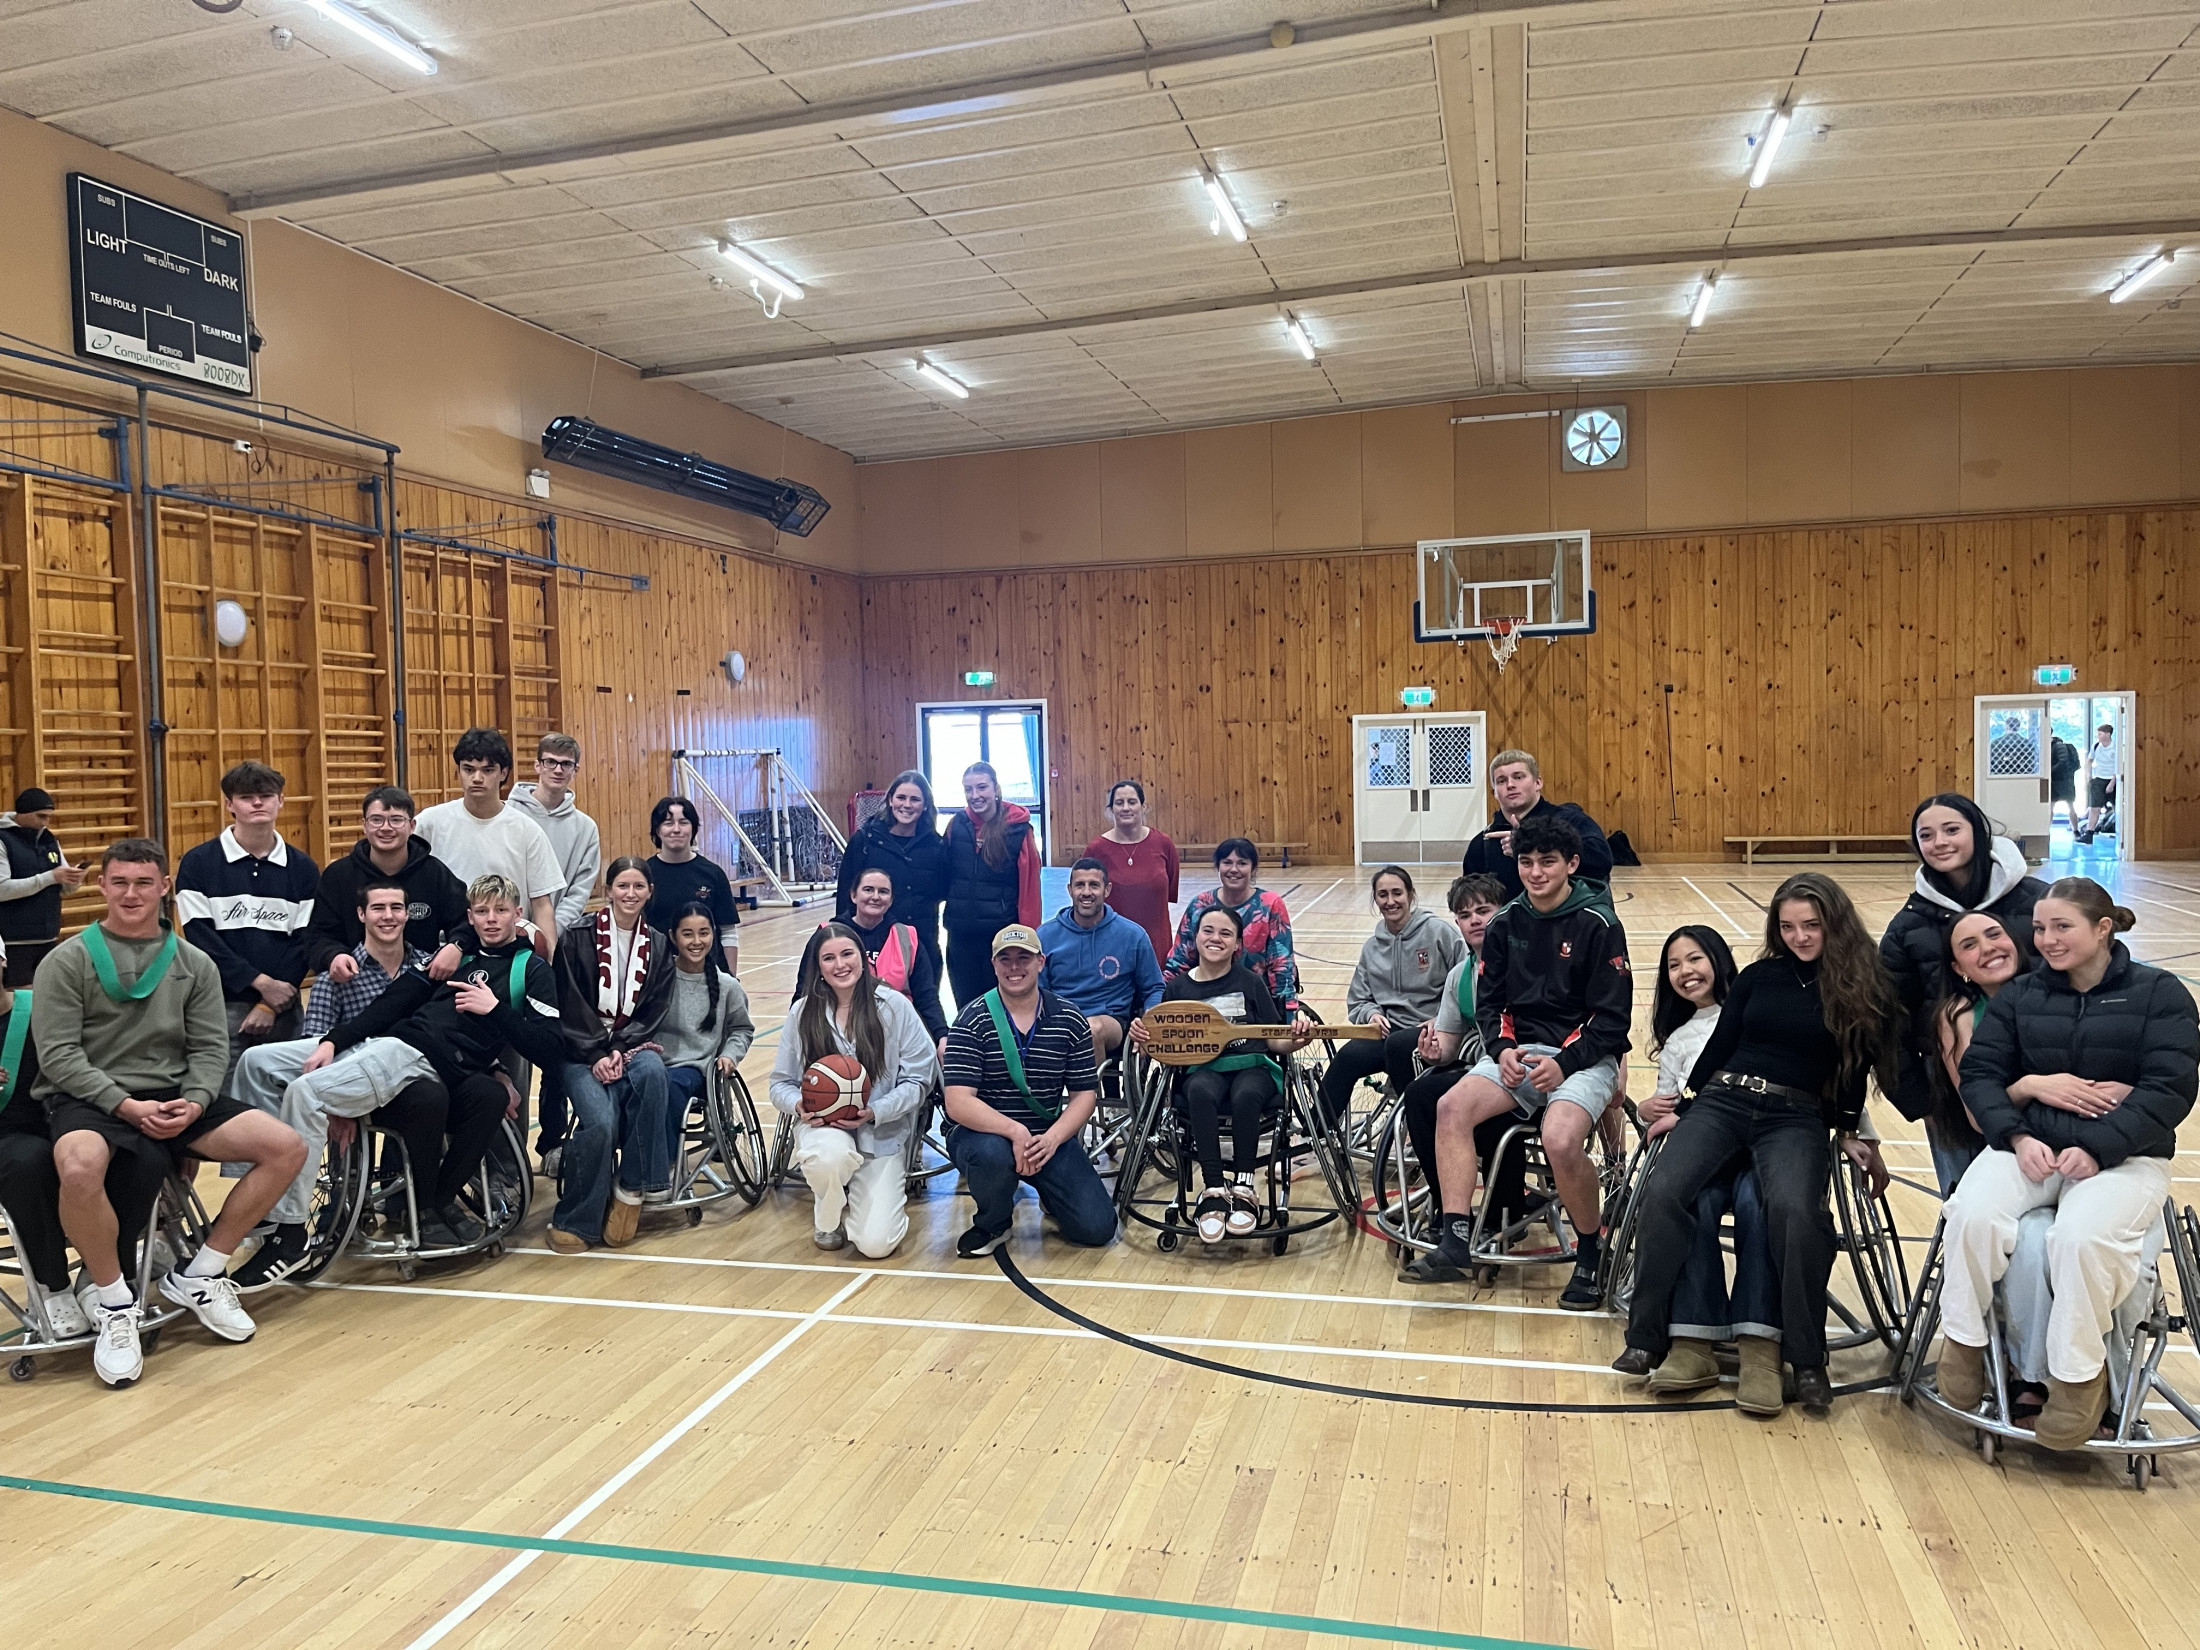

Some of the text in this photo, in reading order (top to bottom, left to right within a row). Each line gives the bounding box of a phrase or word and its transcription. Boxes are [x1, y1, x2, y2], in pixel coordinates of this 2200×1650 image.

[98, 194, 115, 207] SUBS
[87, 228, 127, 254] LIGHT
[210, 235, 226, 247] SUBS
[143, 254, 190, 275] TIME OUTS LEFT
[204, 268, 239, 292] DARK
[90, 292, 137, 313] TEAM FOULS
[201, 324, 242, 344] TEAM FOULS
[114, 345, 181, 371] Computronics
[158, 345, 183, 358] PERIOD
[222, 901, 290, 924] Air Space
